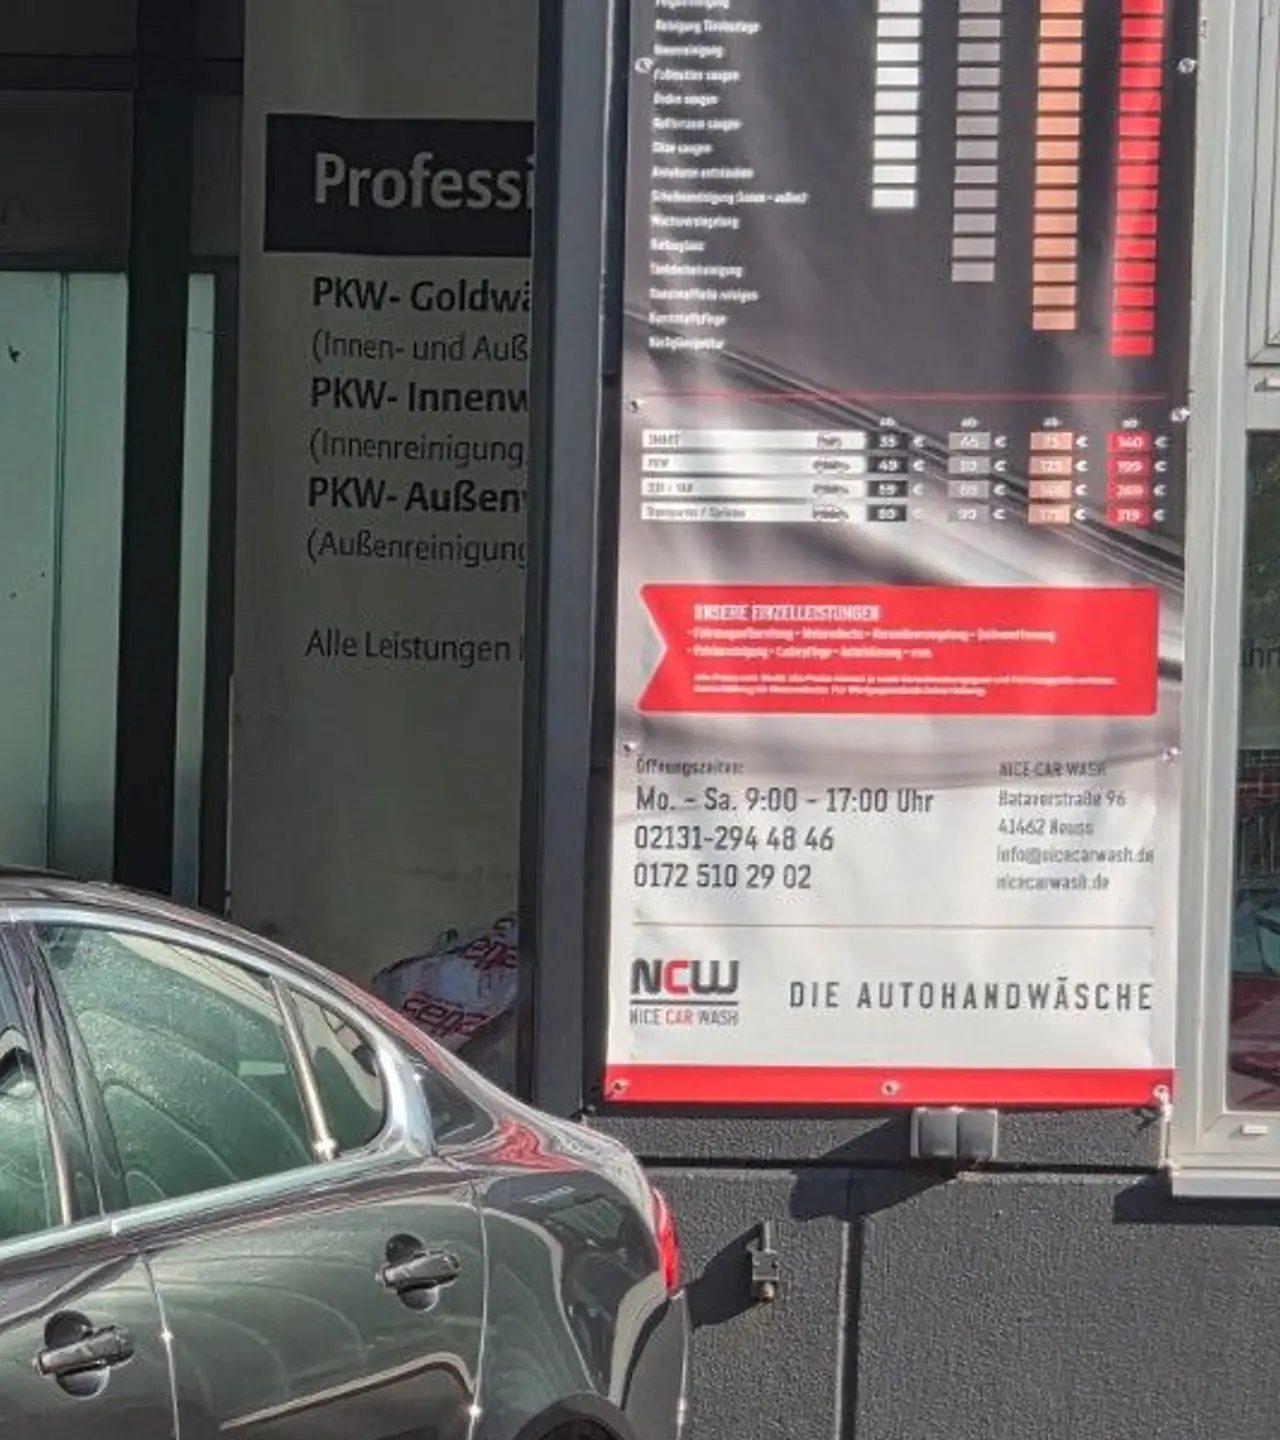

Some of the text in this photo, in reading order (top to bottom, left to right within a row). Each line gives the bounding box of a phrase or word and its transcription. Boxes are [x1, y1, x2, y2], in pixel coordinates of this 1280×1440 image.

[313, 150, 534, 210] Professi
[312, 275, 400, 311] PKW-
[312, 328, 405, 363] (Innen-
[412, 333, 465, 362] und
[310, 376, 399, 412] PKW-
[307, 476, 527, 514] PKW- Außen
[305, 630, 511, 668] Alle Leistungen
[636, 785, 676, 811] Mo.
[703, 787, 737, 811] Sa.
[745, 787, 797, 811] 9:00
[826, 787, 888, 812] 17:00
[897, 787, 934, 812] Uhr
[1106, 789, 1127, 807] 96
[634, 825, 834, 851] 02131-294 48 46
[634, 863, 811, 888] 0172 510 29 02
[630, 958, 740, 995] NCW
[790, 977, 1154, 1011] DIE AUTOHANDWÄSCHE
[630, 1008, 738, 1027] NICE CAR WASH
